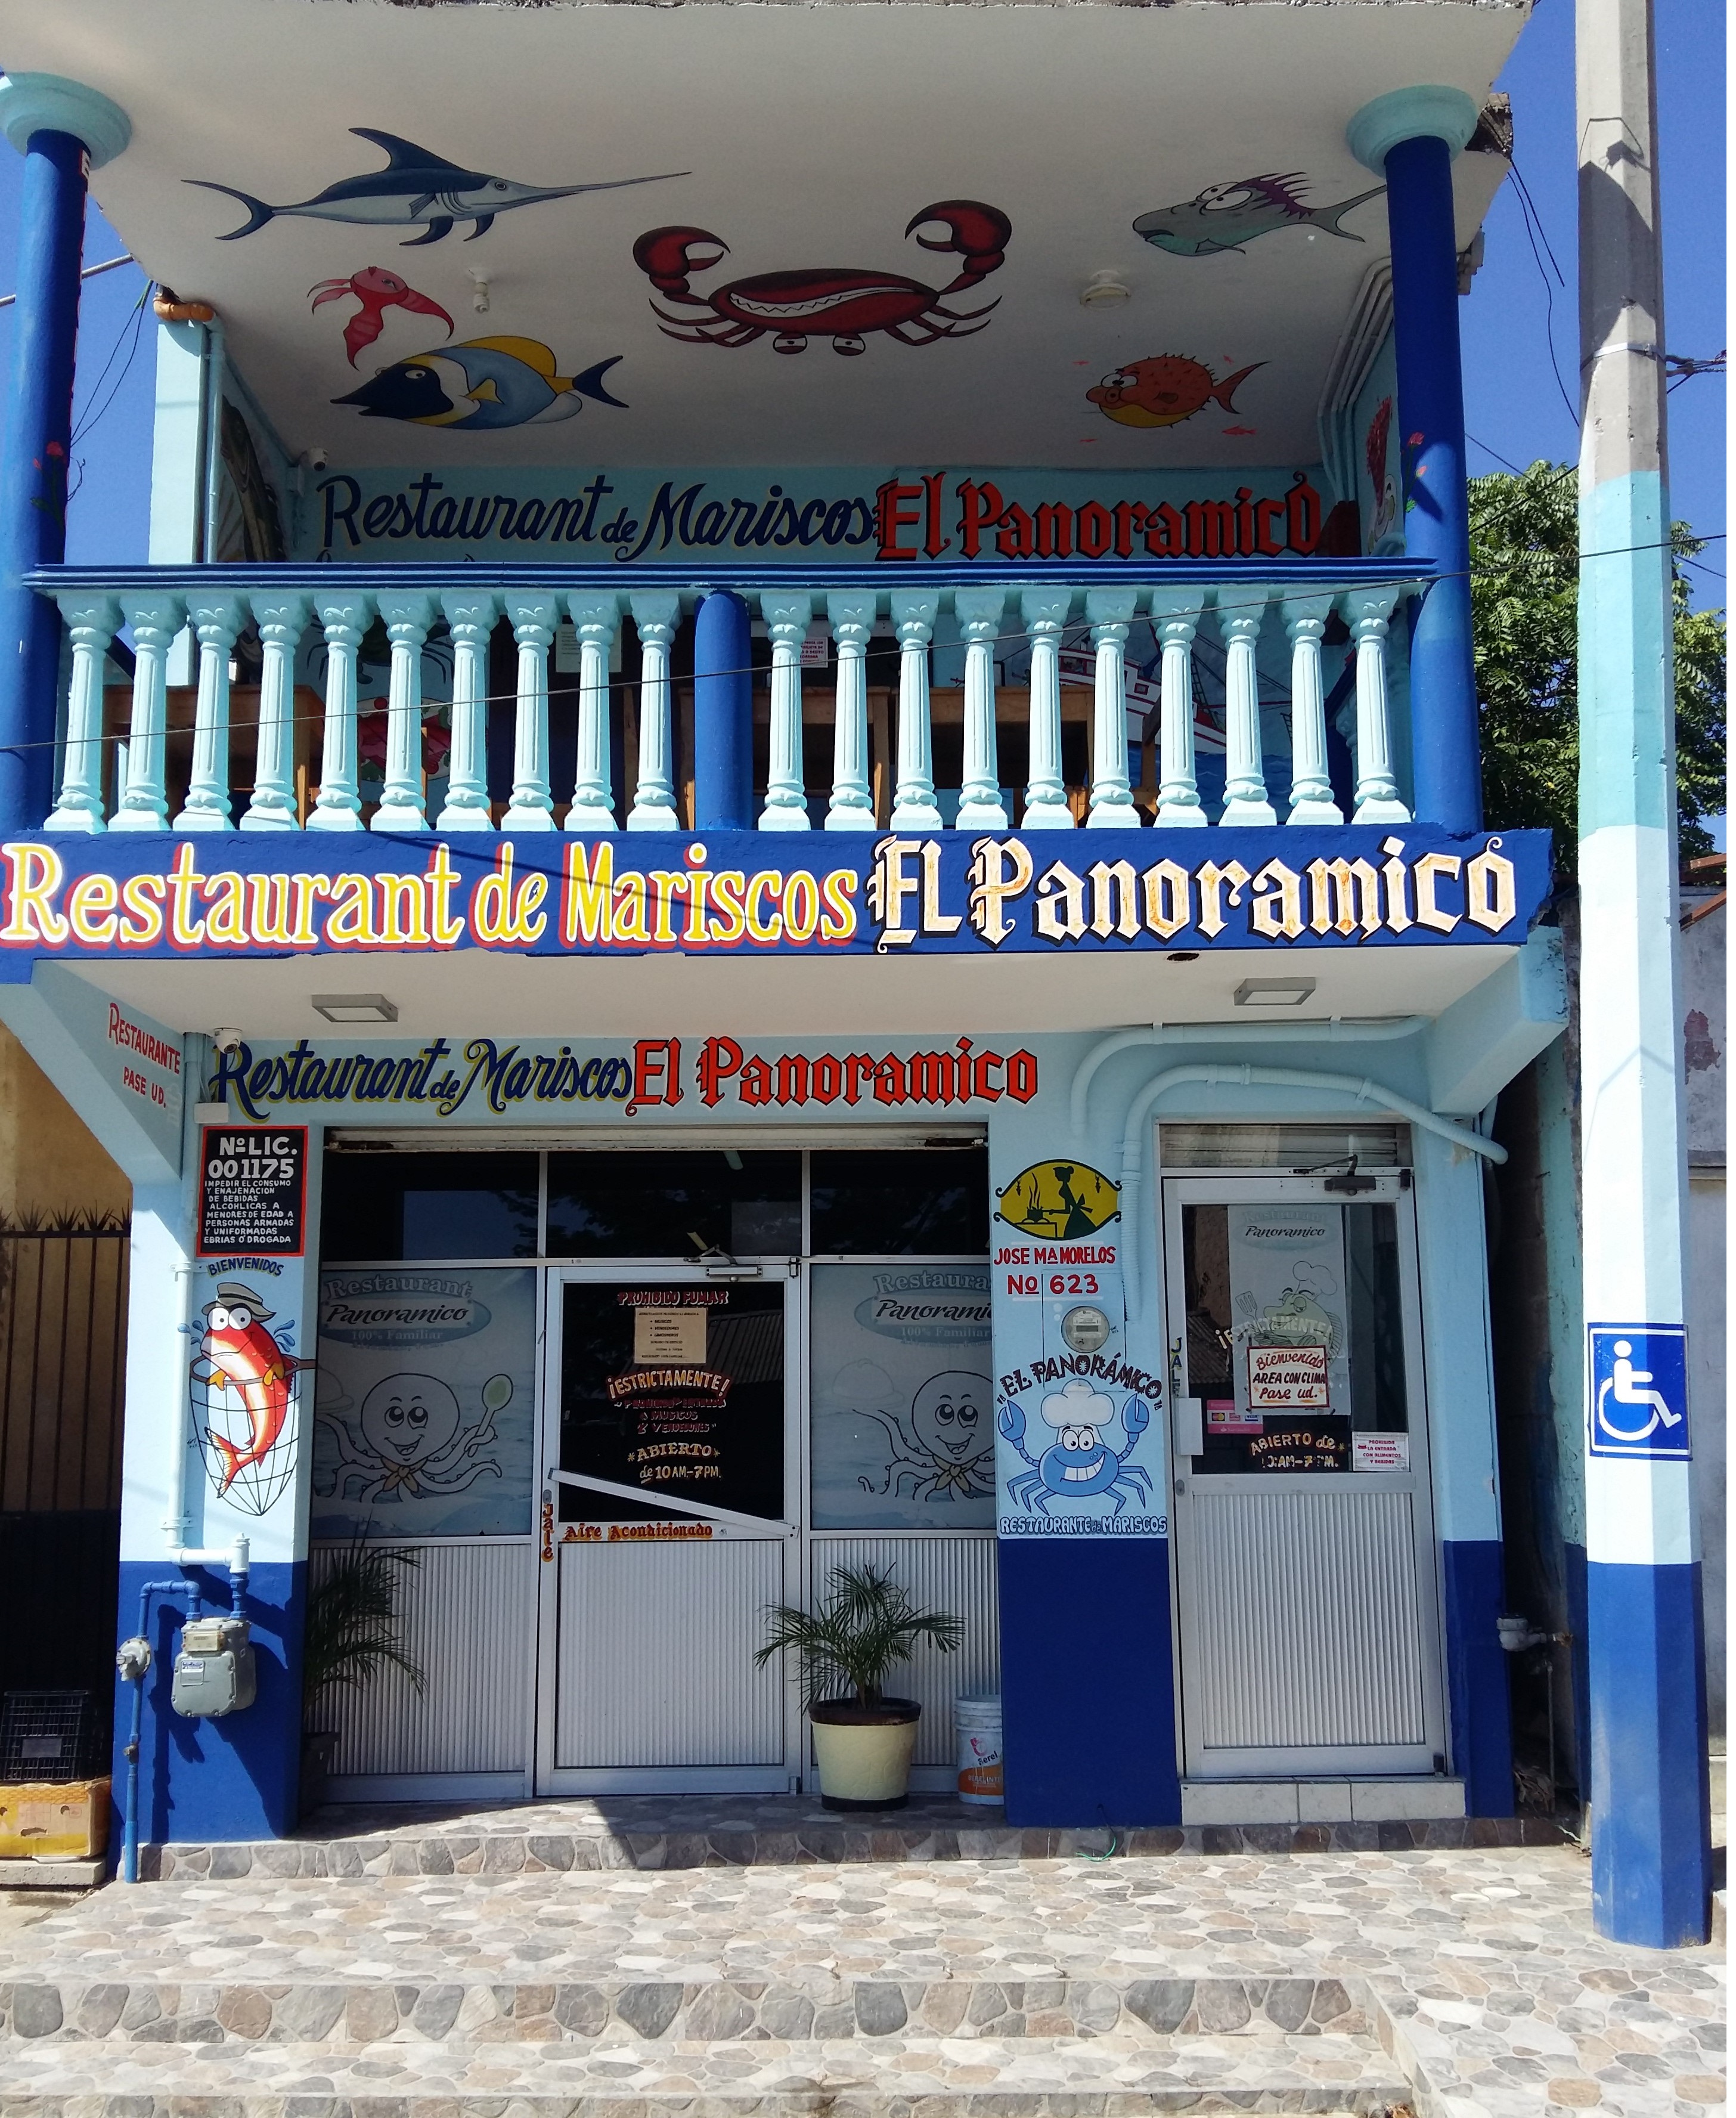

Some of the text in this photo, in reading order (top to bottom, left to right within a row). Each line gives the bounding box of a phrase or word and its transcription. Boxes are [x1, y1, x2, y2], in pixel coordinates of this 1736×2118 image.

[315, 472, 613, 547] Restaurant
[873, 470, 951, 561] El
[601, 507, 635, 544] de
[615, 481, 875, 562] Mariscos
[0, 841, 461, 952] Restaurant
[472, 841, 550, 949] de
[562, 841, 858, 949] Mariscos
[108, 1002, 181, 1075] RESTAURANTE
[123, 1066, 166, 1108] PASE UD.
[208, 1036, 1039, 1123] Restaurant de Mariscos El Panoramico
[208, 1159, 294, 1179] 001175
[1245, 1225, 1326, 1238] Panoramico
[994, 1247, 1030, 1265] JOSE
[1059, 1246, 1117, 1265] MORELOS
[207, 1257, 284, 1277] BIENVENIDOS
[326, 1274, 473, 1299] Restaurant
[873, 1270, 990, 1295] Restaura
[1049, 1274, 1099, 1295] 623
[683, 1290, 729, 1305] FUMAR
[326, 1304, 470, 1324] Panoramico
[876, 1299, 992, 1321] Panorami
[388, 1329, 444, 1340] Familiar
[936, 1327, 990, 1337] Familiar
[1256, 1353, 1323, 1371] Bienvenido
[1253, 1371, 1326, 1384] AREA CON CLIMA
[1258, 1385, 1318, 1399] Pase ud.
[637, 1442, 712, 1462] ABIERTO
[1251, 1433, 1336, 1456] ABIERTO de
[639, 1464, 653, 1480] de
[563, 1521, 714, 1541] Aire Acondicionado
[1000, 1516, 1168, 1534] RESTAURANTE de MARISCOS
